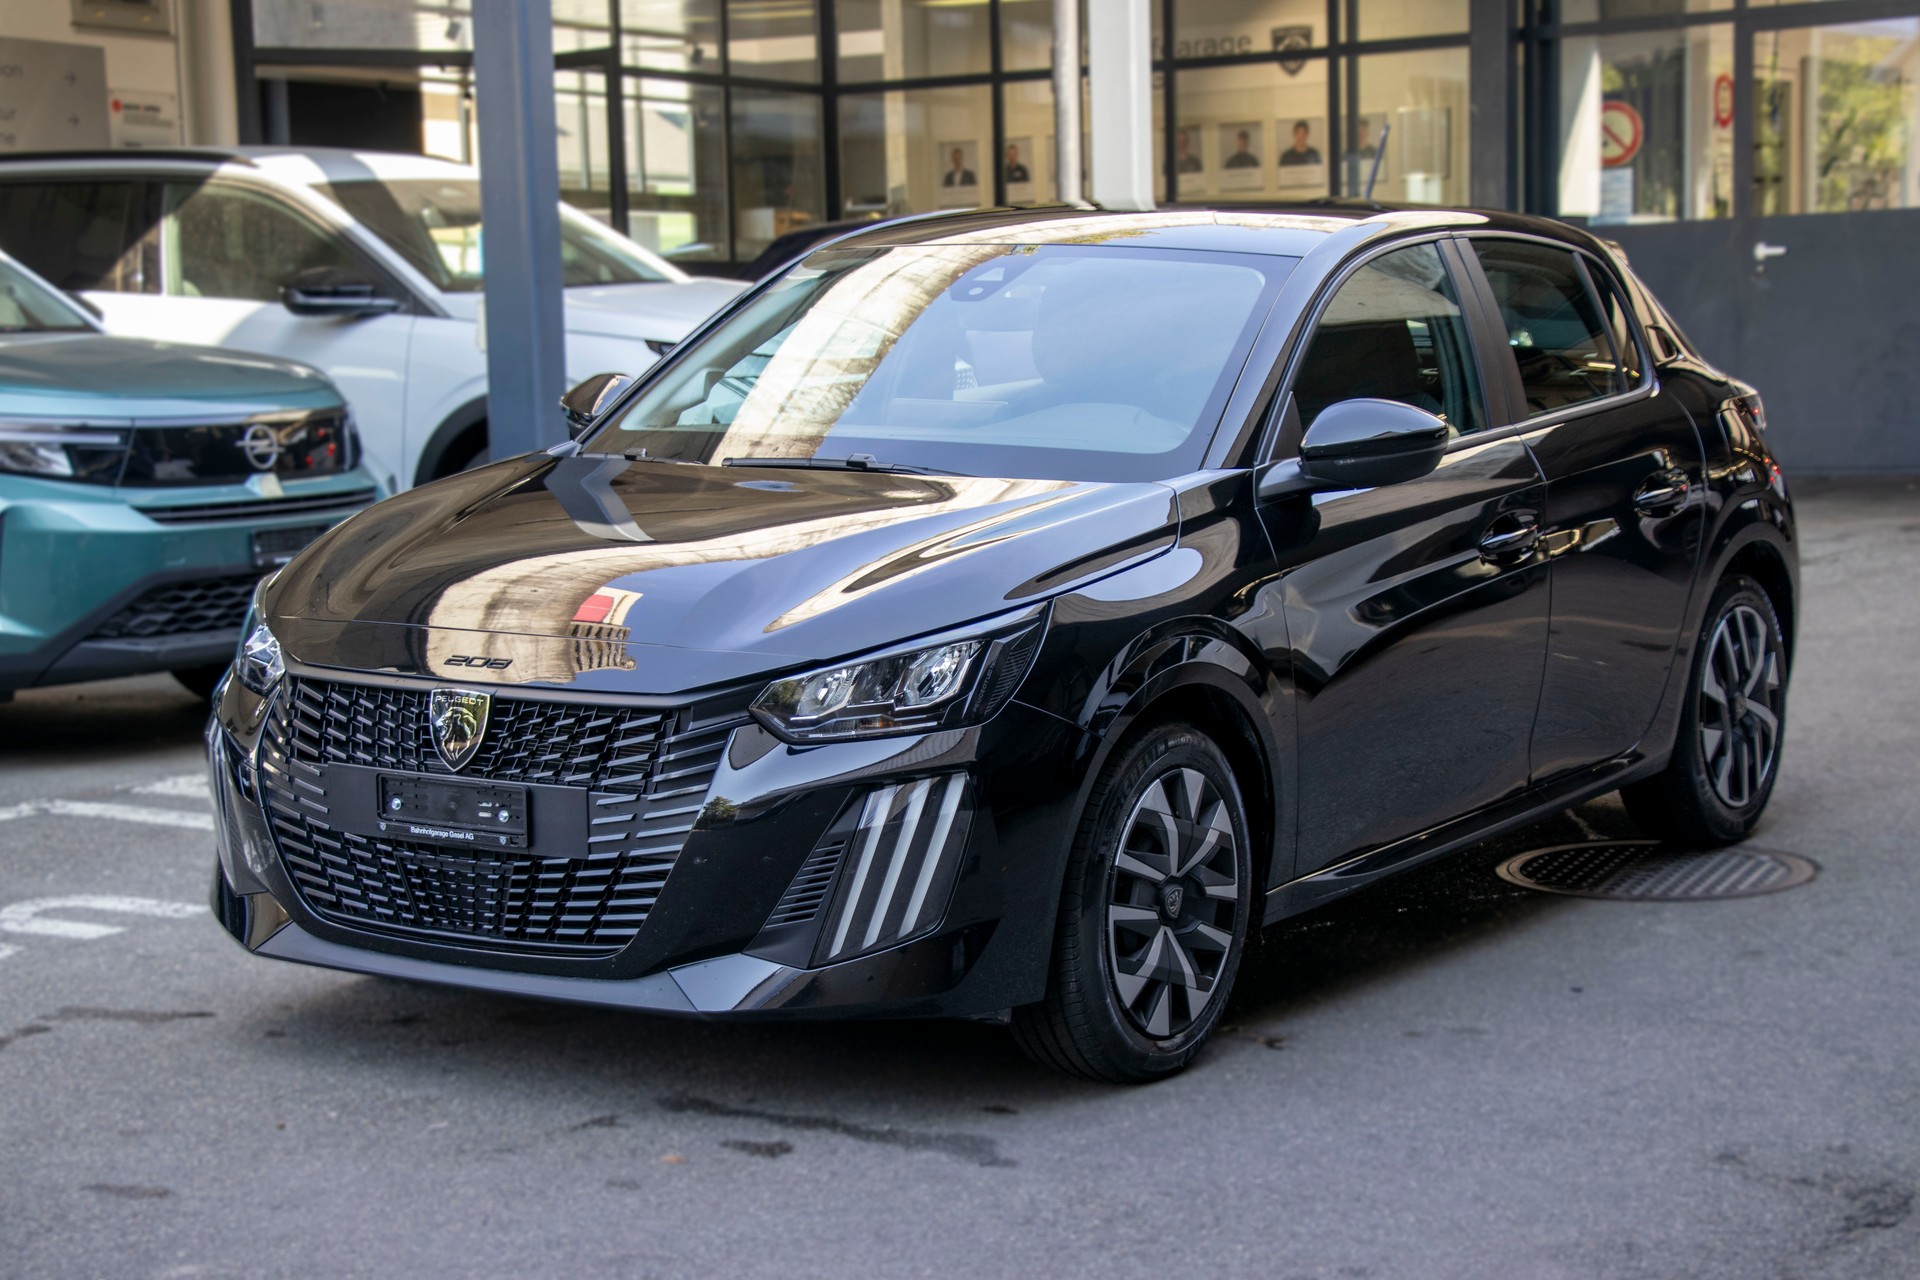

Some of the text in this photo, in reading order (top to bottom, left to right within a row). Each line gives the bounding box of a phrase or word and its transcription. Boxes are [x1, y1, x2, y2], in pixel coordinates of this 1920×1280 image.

[443, 654, 514, 670] 208
[434, 695, 484, 706] PEUGEOT
[464, 832, 475, 840] AG
